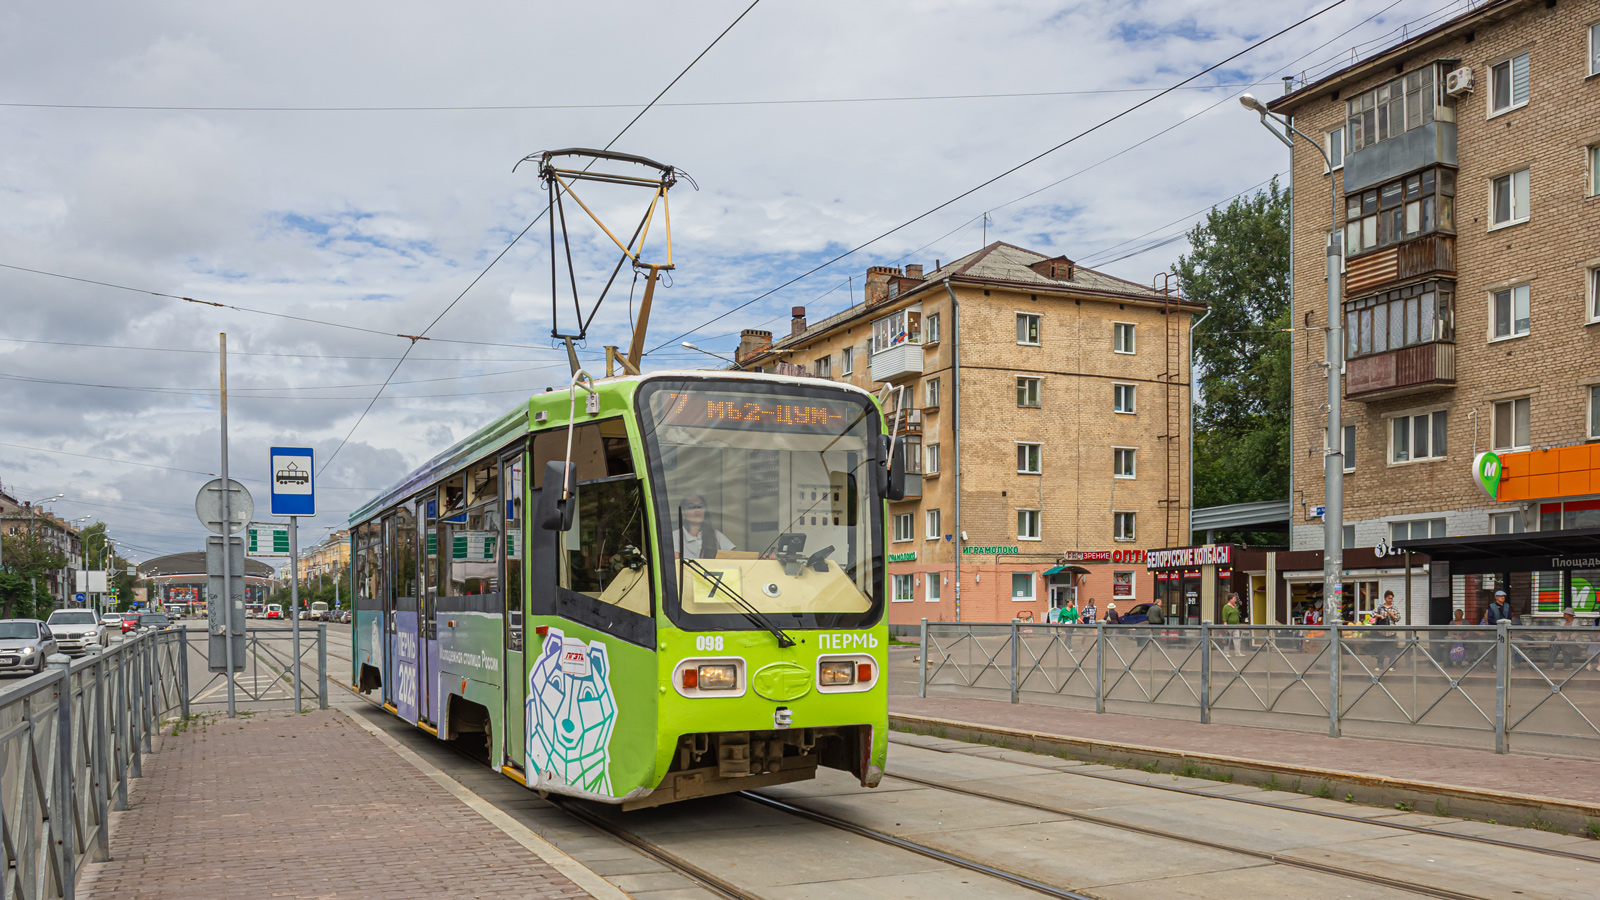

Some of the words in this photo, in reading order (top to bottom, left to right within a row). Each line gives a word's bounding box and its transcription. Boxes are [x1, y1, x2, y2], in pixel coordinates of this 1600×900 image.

[670, 393, 687, 414] 7
[1484, 461, 1497, 477] М
[962, 546, 1019, 555] ИГРАМОЛОКО
[1147, 548, 1193, 568] БЕЛОРУССКИЕ
[1194, 546, 1228, 565] КОЛБАСЫ
[1551, 557, 1600, 568] Площадь
[703, 571, 725, 598] 7
[398, 631, 416, 659] ПЕРМЬ
[696, 635, 724, 651] 098
[818, 633, 879, 650] ПЕРМЬ
[481, 649, 499, 672] России
[398, 663, 416, 707] 2025
